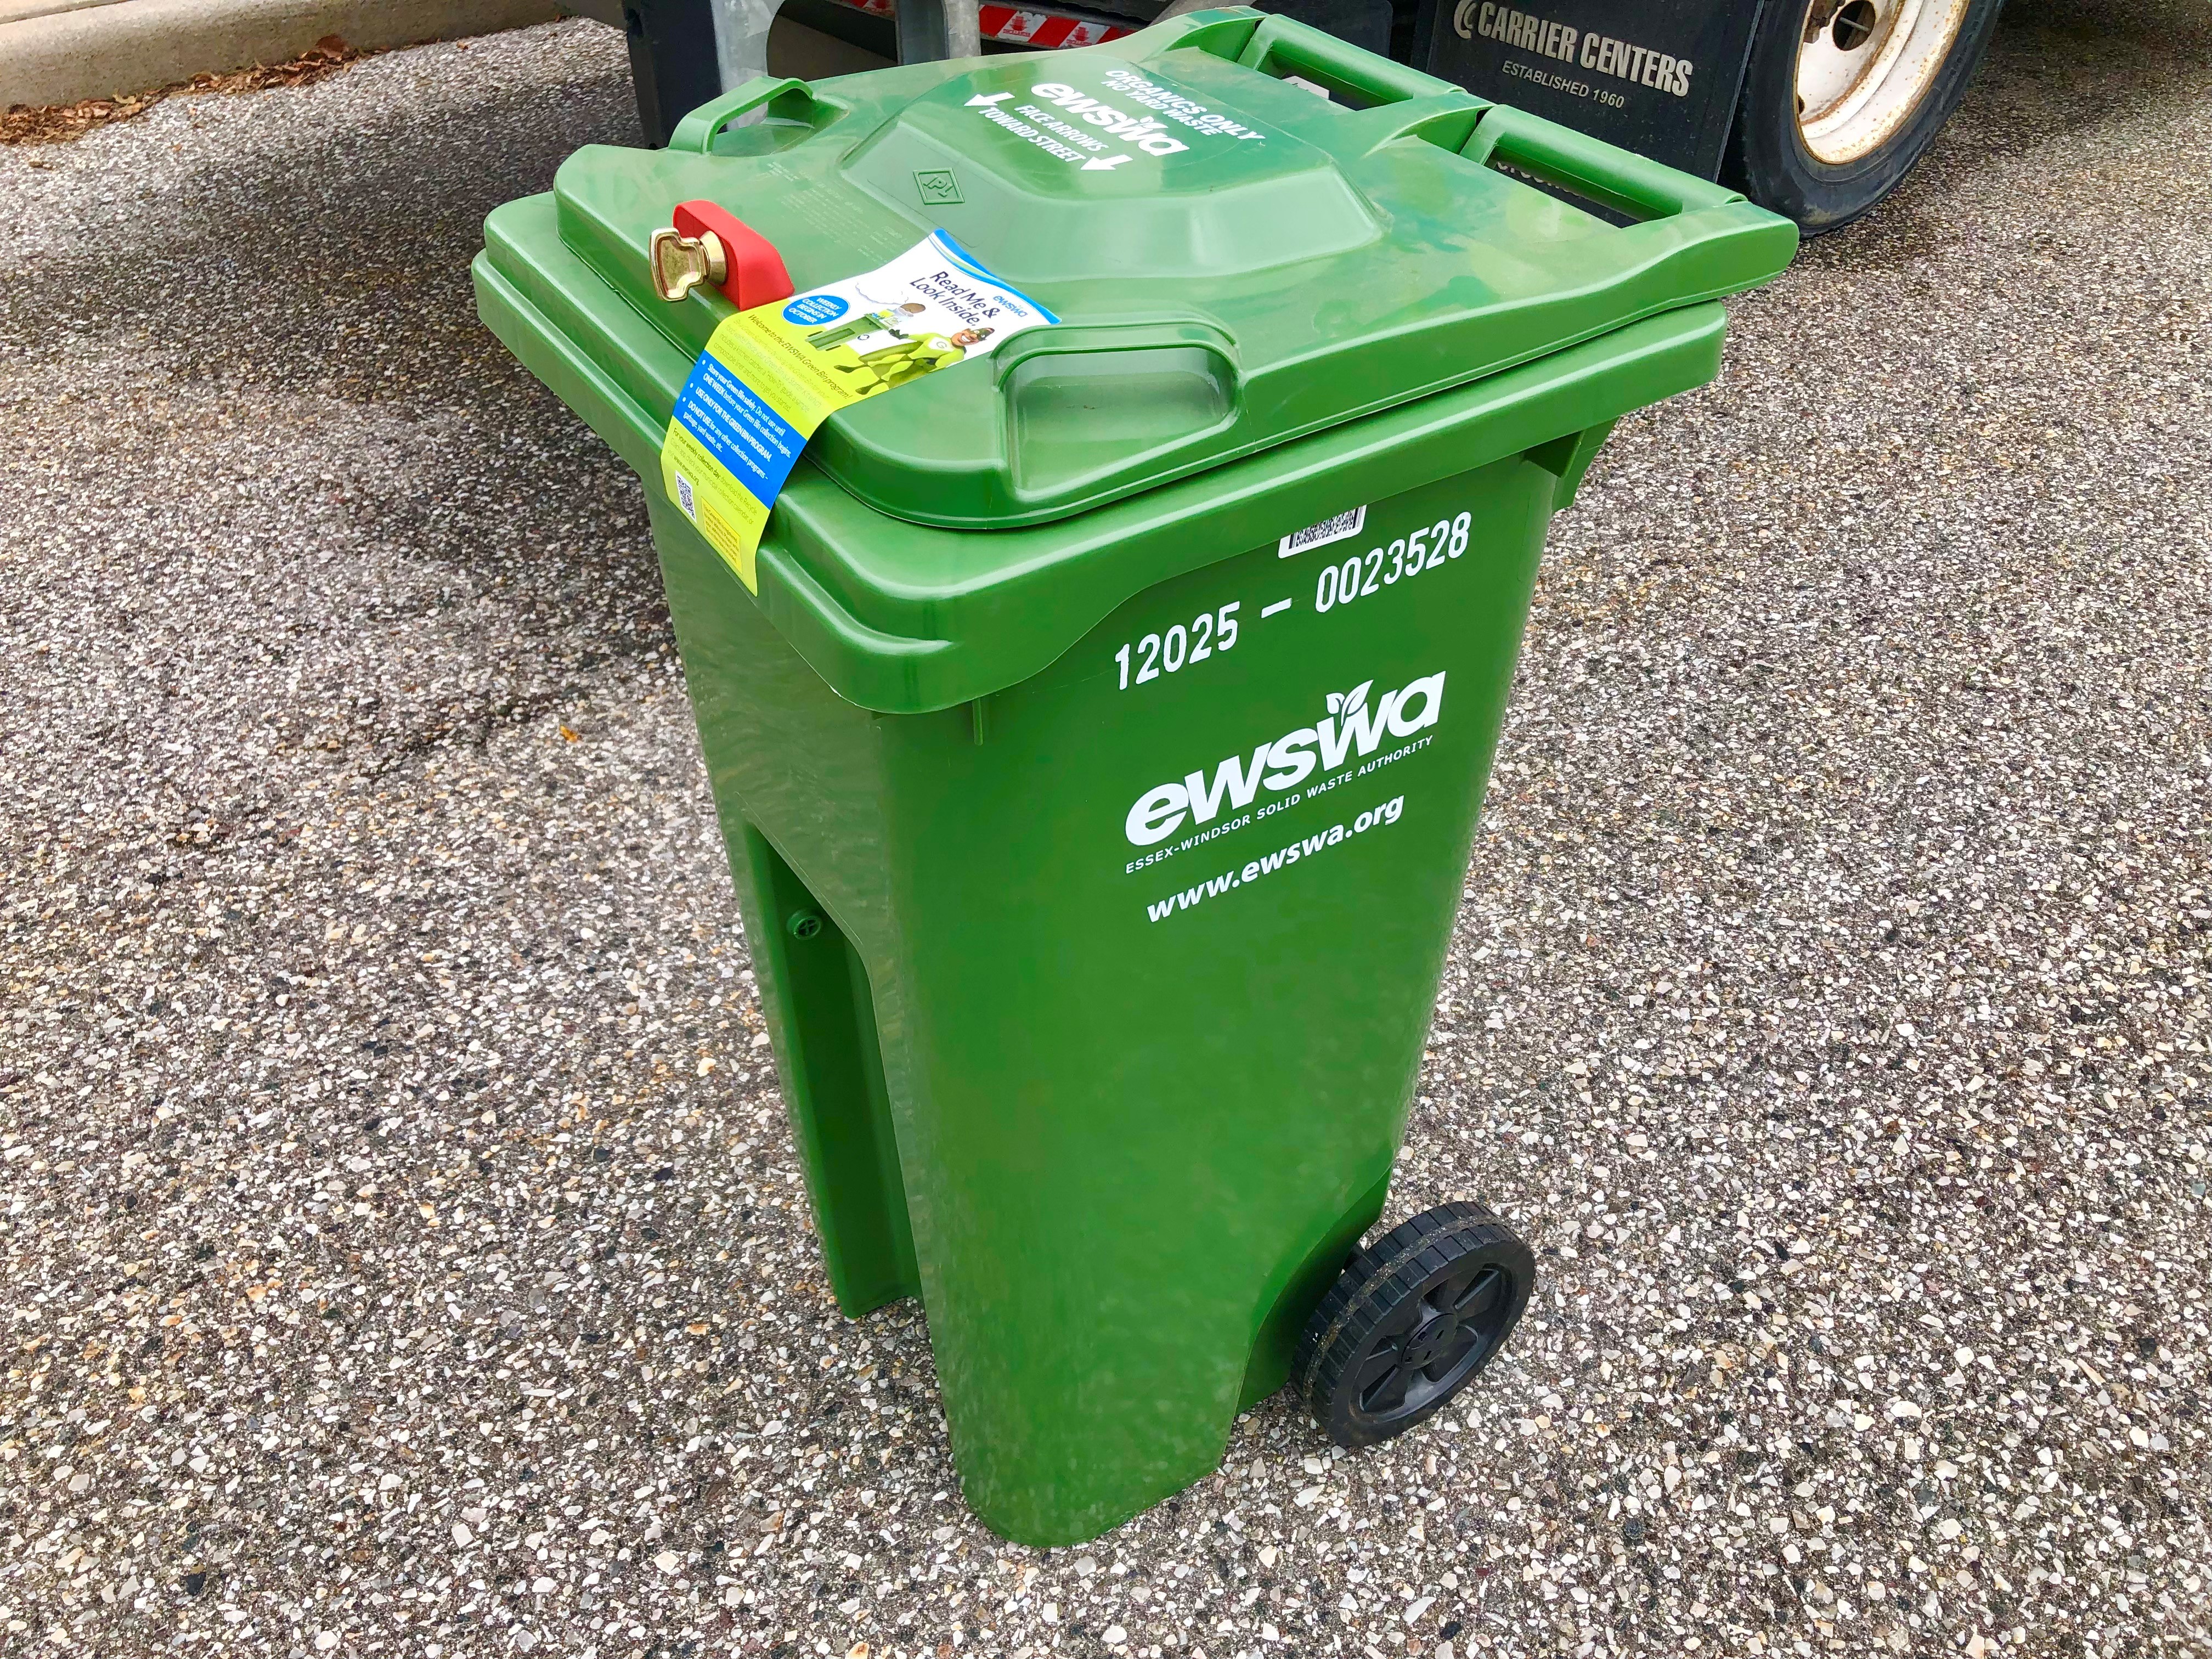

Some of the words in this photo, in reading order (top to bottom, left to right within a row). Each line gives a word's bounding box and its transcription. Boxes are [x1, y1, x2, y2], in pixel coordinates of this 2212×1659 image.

[1478, 2, 1577, 63] CARRIER
[1580, 32, 1693, 97] CENTERS
[1101, 80, 1131, 91] NO
[1125, 91, 1169, 110] YARD
[1163, 109, 1223, 136] WASTE
[1105, 70, 1207, 114] ORGANICS
[1200, 114, 1266, 139] ONLY
[1502, 60, 1589, 97] ESTABLISHED
[1592, 89, 1624, 109] 1960
[978, 107, 1039, 138] TOWARD
[1028, 136, 1086, 162] STREET
[1014, 104, 1055, 123] FACE
[1042, 121, 1109, 151] ARROWS
[1030, 83, 1189, 156] ewswa
[788, 307, 817, 323] OCTOBER
[797, 303, 821, 316] BEGINS
[802, 297, 838, 317] COLLECTION
[816, 297, 842, 310] WEEKLY
[910, 278, 945, 300] Look
[939, 297, 979, 326] Inside.
[930, 271, 970, 296] Read
[960, 292, 986, 309] Me
[981, 307, 1000, 319] &
[992, 295, 1029, 318] ewswa
[713, 342, 736, 364] compostable
[743, 368, 753, 377] and
[749, 374, 761, 386] more
[762, 386, 771, 394] get
[769, 391, 778, 400] you
[748, 314, 771, 334] Welcome
[774, 335, 785, 346] the
[781, 342, 806, 362] EWSWA
[802, 359, 820, 373] Green
[816, 370, 828, 381] Bin
[822, 375, 853, 399] program!
[695, 386, 706, 399] USE
[702, 393, 716, 407] ONLY
[712, 402, 724, 416] FOR
[721, 410, 731, 423] THE
[728, 418, 744, 435] GREEN
[741, 429, 752, 442] BIN
[748, 436, 772, 461] PROGRAM.
[703, 373, 715, 386] ONE
[712, 380, 726, 396] WEEK
[723, 391, 736, 407] before
[733, 403, 744, 414] your
[743, 409, 755, 424] Green
[753, 419, 761, 430] Bin
[760, 427, 778, 446] collection
[777, 441, 791, 458] begins.
[707, 363, 720, 377] Store
[716, 373, 728, 385] your
[726, 380, 739, 396] Green
[737, 389, 746, 401] Bin
[743, 397, 757, 411] safely.
[755, 406, 763, 416] Do
[760, 413, 770, 423] not
[768, 419, 776, 429] use
[774, 425, 786, 437] until
[683, 411, 698, 429] garbage,
[697, 424, 707, 436] yard
[705, 431, 716, 447] waste,
[687, 400, 697, 411] DO
[693, 406, 706, 419] NOT
[702, 414, 712, 427] USE
[714, 427, 723, 438] any
[721, 434, 732, 446] other
[730, 443, 749, 462] collection
[747, 459, 765, 478] programs
[674, 456, 699, 486] www.ewswa.org
[678, 434, 687, 444] your
[686, 442, 698, 458] weekly
[697, 454, 714, 472] collection
[720, 476, 738, 496] download
[743, 497, 757, 516] Recycle
[717, 487, 734, 506] collection
[1115, 601, 1240, 690] 12025
[1315, 511, 1471, 613] 0023528
[1125, 670, 1446, 846] ewswa
[1125, 814, 1250, 874] ESSEX-WINDSOR
[1257, 793, 1300, 820] SOLID
[1306, 771, 1352, 799] WASTE
[1357, 735, 1434, 777] AUTHORITY
[1147, 795, 1404, 923] www.ewswa.org
